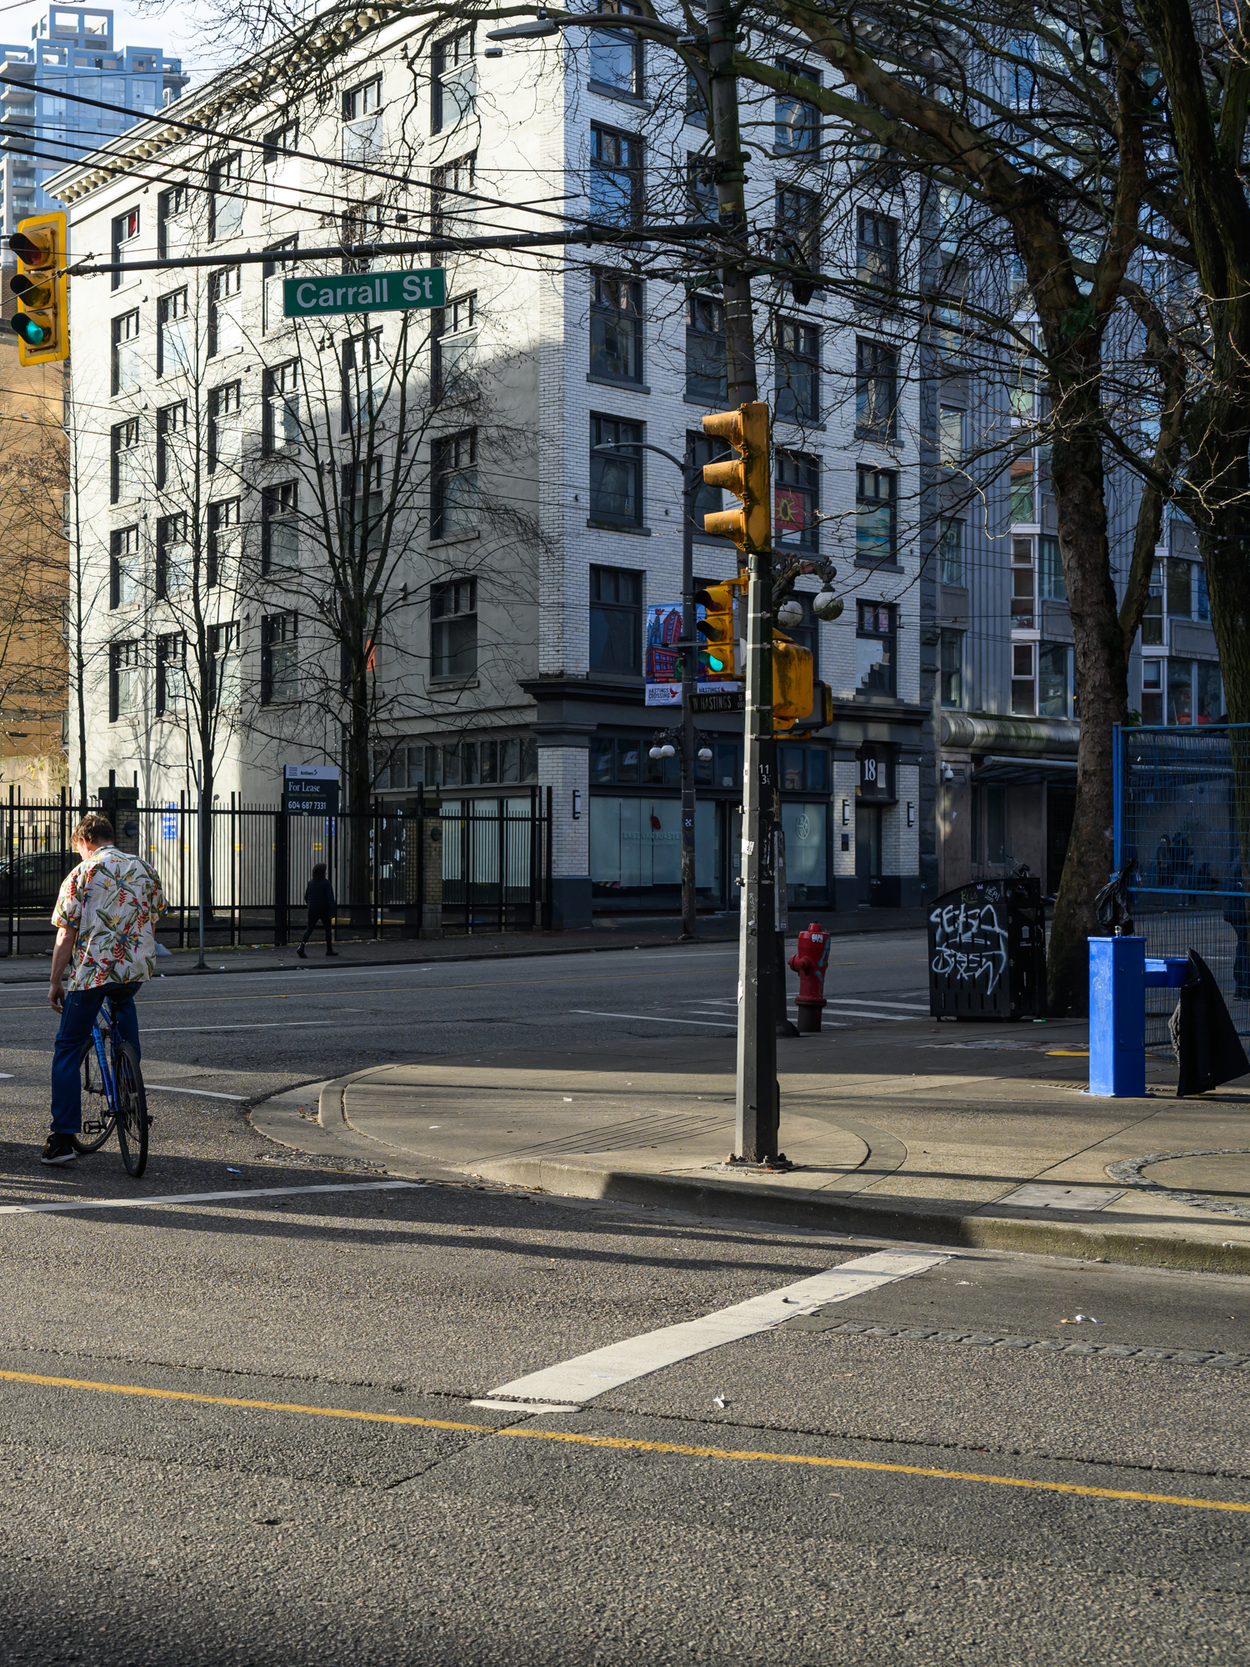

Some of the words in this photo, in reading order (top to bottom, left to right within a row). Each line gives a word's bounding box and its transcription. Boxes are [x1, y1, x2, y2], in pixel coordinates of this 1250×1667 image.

[296, 279, 388, 308] Carrall
[403, 275, 433, 301] St
[700, 695, 732, 710] HASTINGS
[759, 764, 769, 774] 11
[864, 758, 876, 781] 18
[288, 781, 300, 791] For
[302, 782, 320, 792] Lease
[288, 801, 300, 809] 604
[301, 801, 313, 809] 687
[314, 801, 327, 810] 7331
